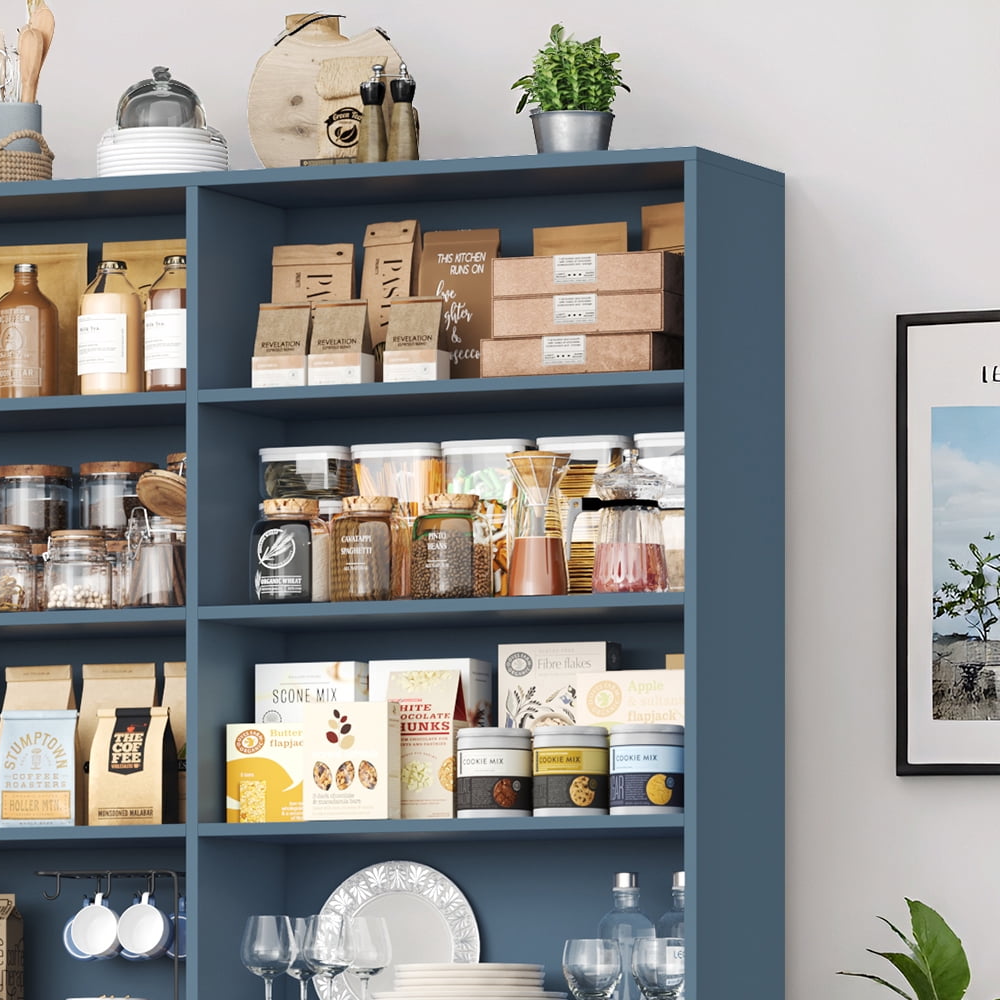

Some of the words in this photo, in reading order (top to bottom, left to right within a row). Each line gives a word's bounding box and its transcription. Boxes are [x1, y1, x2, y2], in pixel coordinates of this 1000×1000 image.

[437, 253, 453, 264] THIS
[454, 252, 486, 263] KITCHEN
[450, 265, 469, 275] RUNS
[471, 264, 484, 274] ON
[444, 301, 473, 331] ghter
[392, 334, 432, 342] REVELATION
[451, 326, 461, 343] &
[261, 340, 300, 348] REVELATION
[317, 338, 356, 346] REVELATION
[428, 532, 446, 540] PINTO
[341, 547, 372, 555] SPAGHETTI
[537, 657, 562, 670] Fibre
[563, 656, 592, 669] flakes
[627, 680, 664, 694] Apple
[272, 688, 311, 704] SCONE
[316, 688, 337, 703] MIX
[400, 704, 432, 712] HITE
[400, 712, 451, 720] OCOLATE
[627, 709, 678, 723] flapjack
[113, 732, 145, 742] THE
[270, 729, 303, 737] Butter
[112, 742, 142, 752] COF
[270, 739, 303, 749] flapjac
[4, 731, 68, 770] STUMPTOWN
[111, 752, 142, 764] FEE
[462, 758, 488, 766] COOKIE
[489, 757, 504, 765] MIX
[538, 756, 564, 765] COOKIE
[566, 756, 582, 764] MIX
[616, 754, 641, 762] COOKIE
[9, 799, 39, 812] HOLLER
[98, 809, 129, 817] MONSOONED
